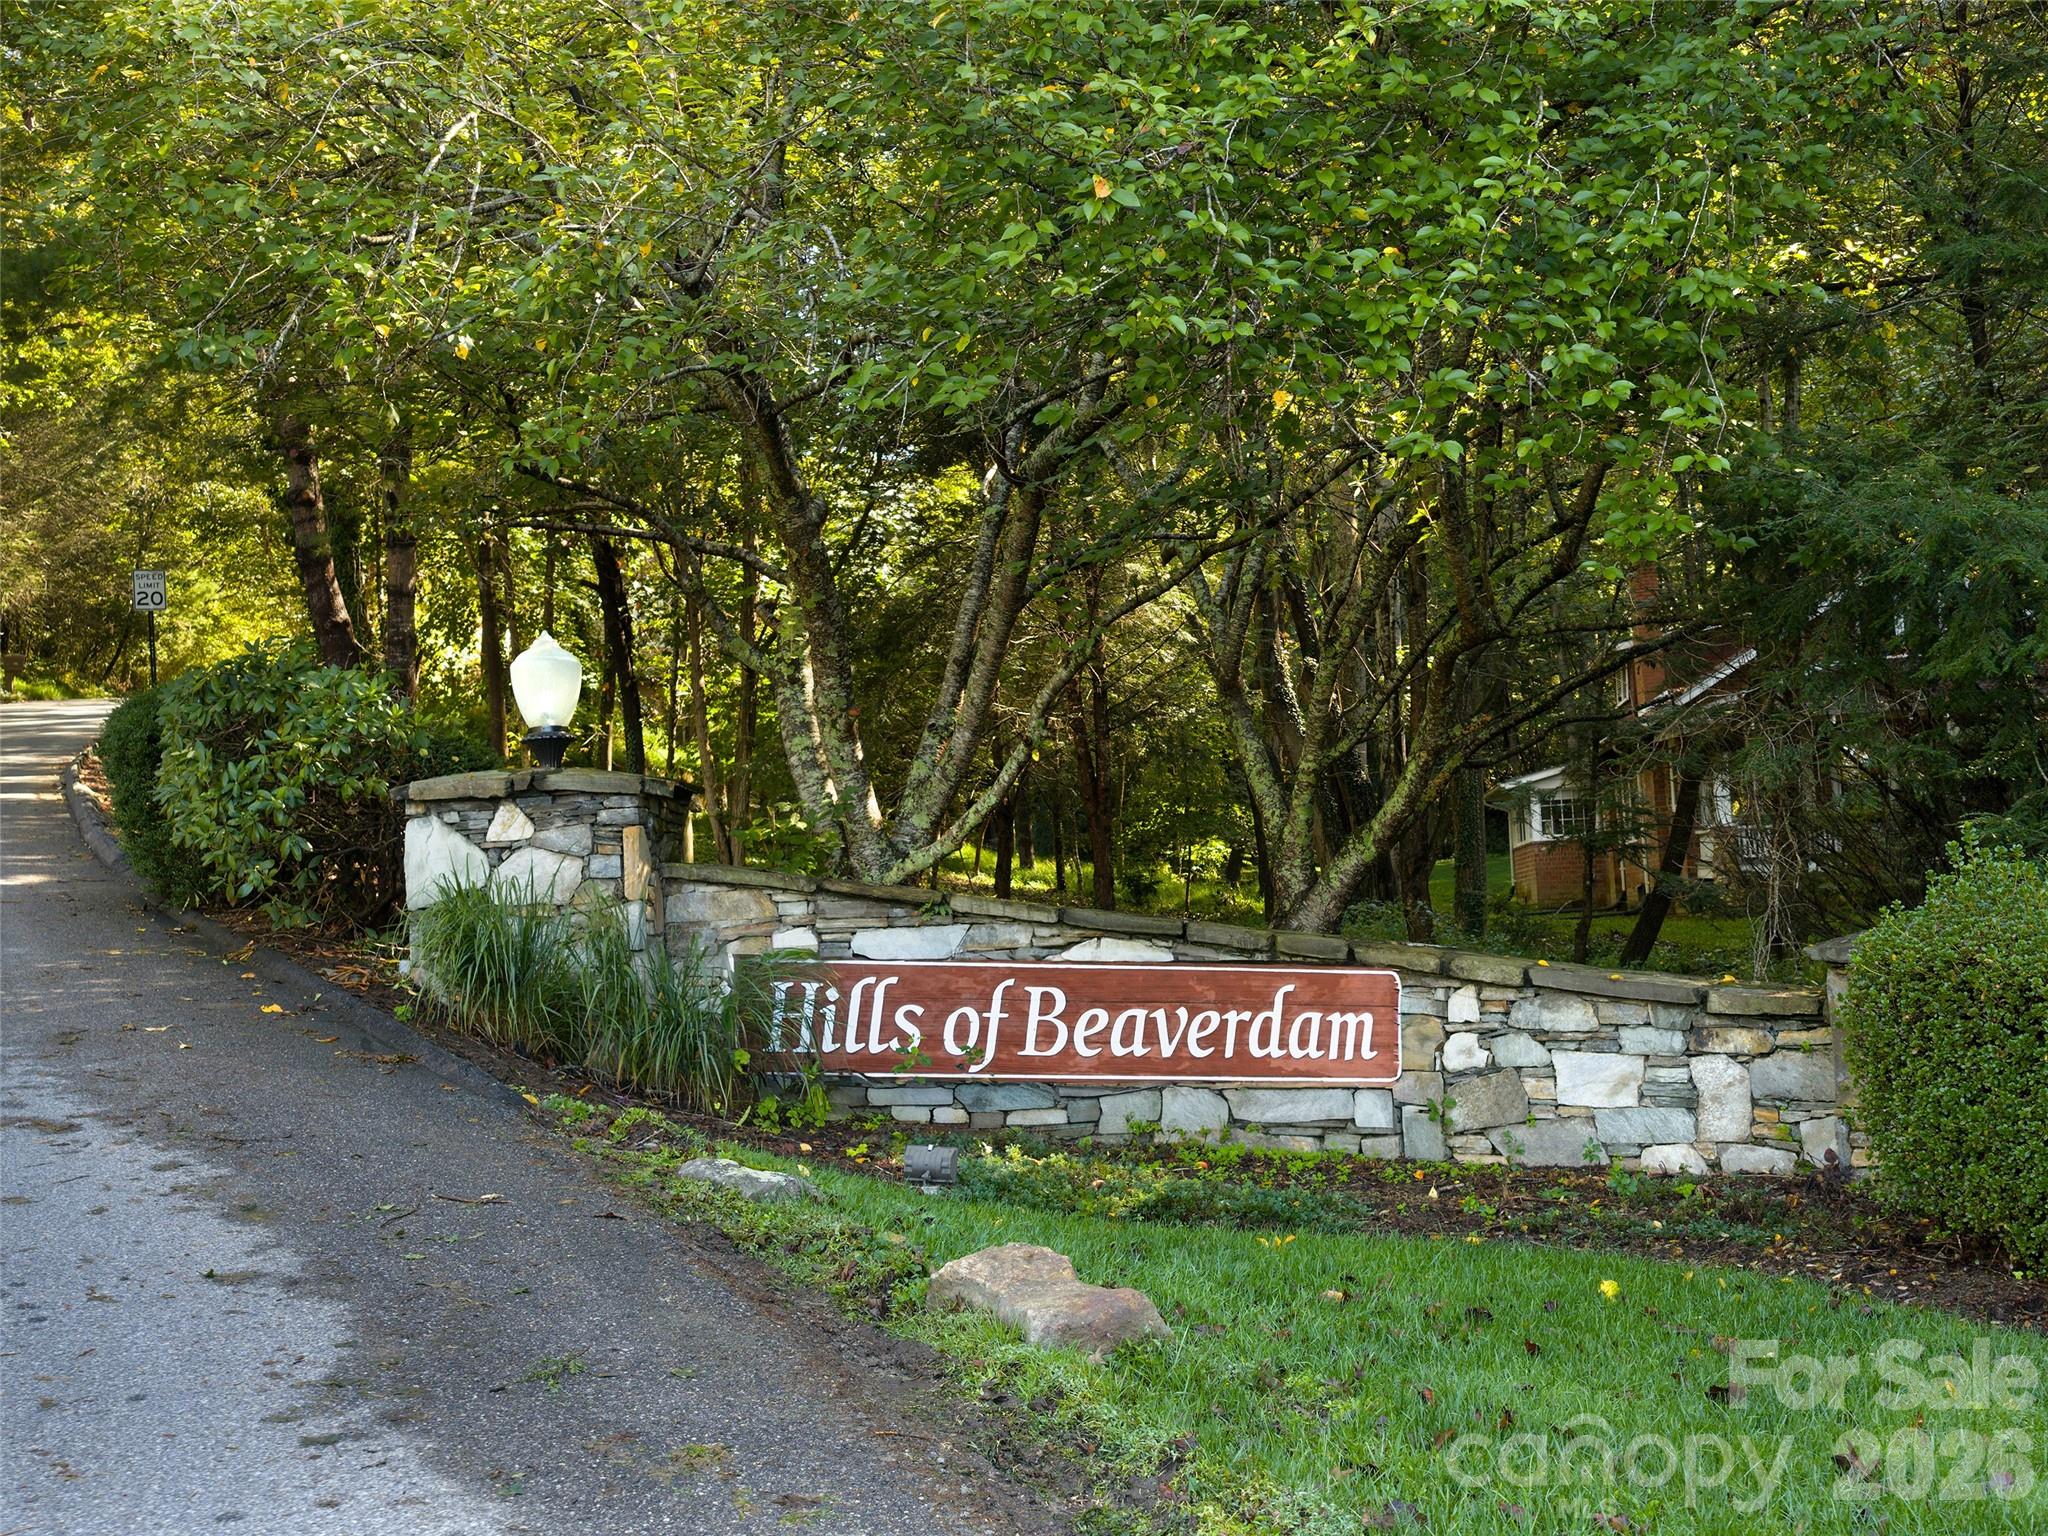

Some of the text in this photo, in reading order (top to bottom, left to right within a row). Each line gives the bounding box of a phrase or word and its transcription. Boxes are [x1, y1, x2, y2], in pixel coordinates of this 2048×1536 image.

[135, 573, 163, 581] SPEED
[136, 591, 164, 606] 20
[764, 976, 1378, 1073] Hills of Beaverdam
